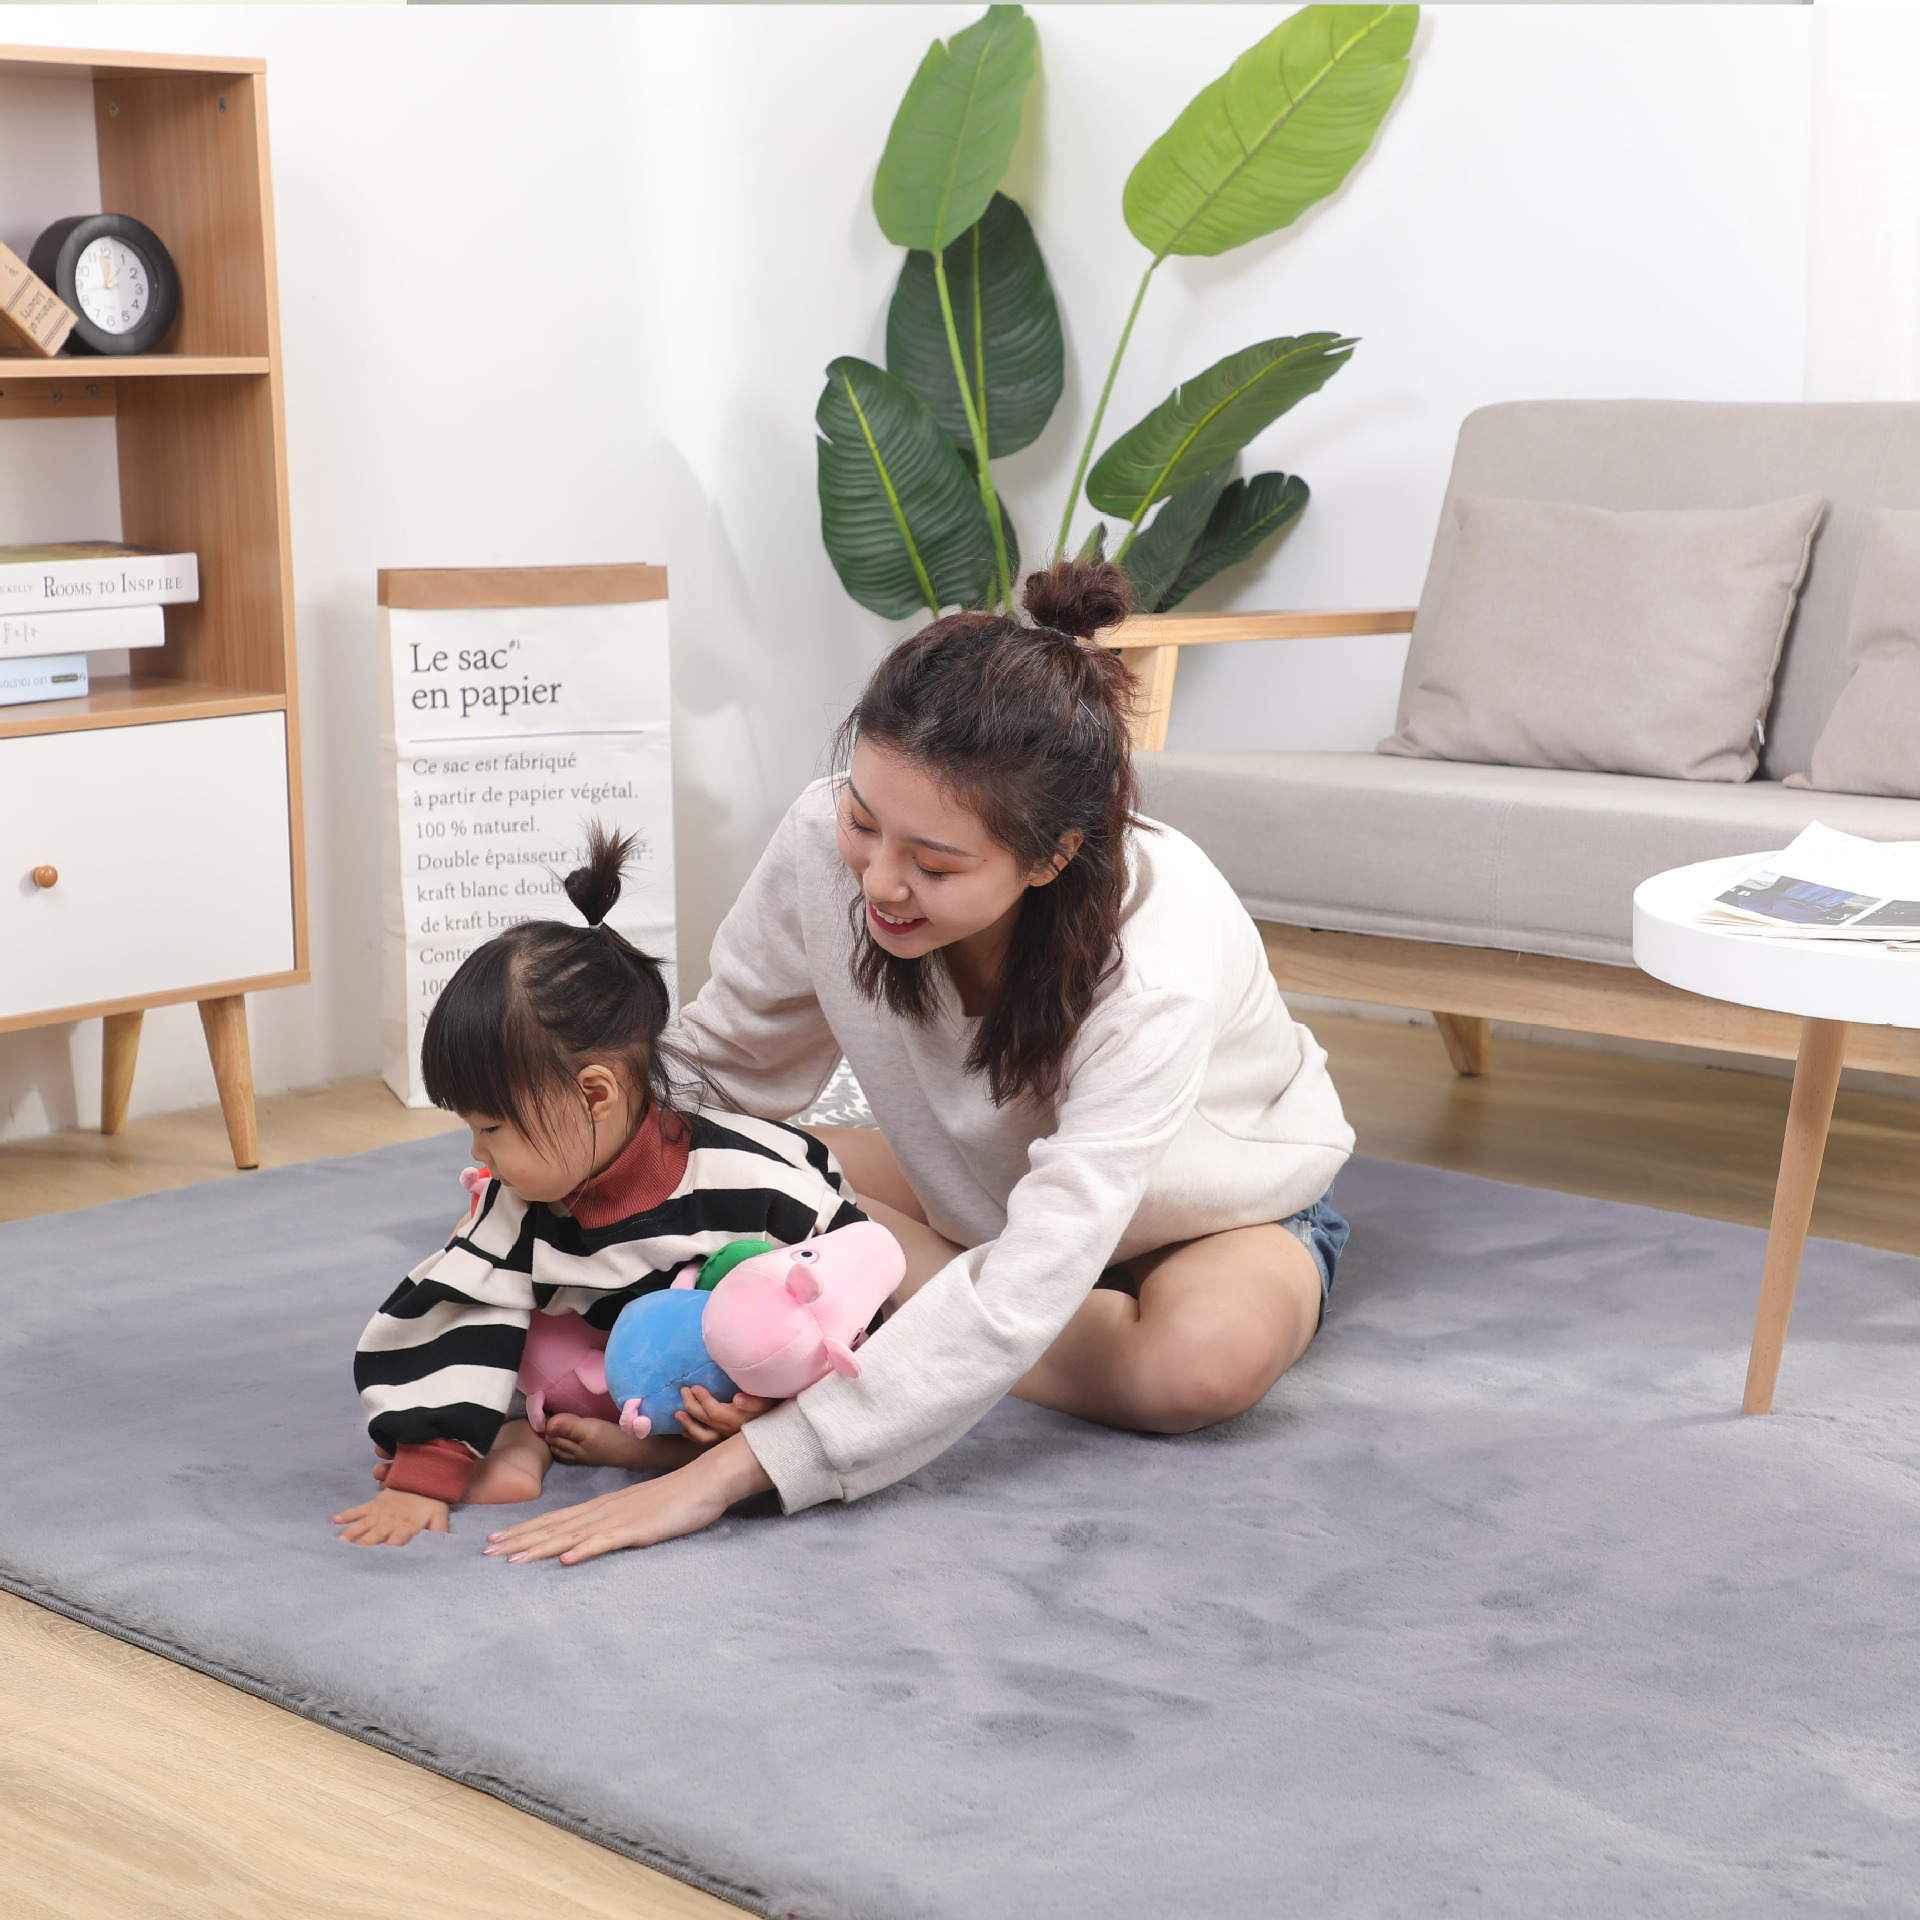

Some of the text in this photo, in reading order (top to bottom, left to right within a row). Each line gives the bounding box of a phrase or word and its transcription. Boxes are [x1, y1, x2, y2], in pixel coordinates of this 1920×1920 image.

[129, 267, 138, 279] 2
[81, 294, 90, 306] 8
[134, 282, 144, 296] 3
[131, 298, 139, 310] 4
[106, 314, 116, 327] 6
[121, 309, 130, 323] 5
[409, 642, 449, 673] Le
[411, 675, 562, 718] en papier
[412, 752, 577, 776] Ce sac est fabriqué
[414, 781, 639, 811] à partir de papier végétal.
[417, 815, 541, 839] 100 % naturel.
[417, 849, 479, 872] Double
[485, 848, 569, 871] épaisseur
[417, 882, 456, 902] kraft
[460, 880, 509, 899] blanc
[421, 916, 440, 934] de
[445, 911, 482, 932] kraft
[420, 946, 475, 965] Conte
